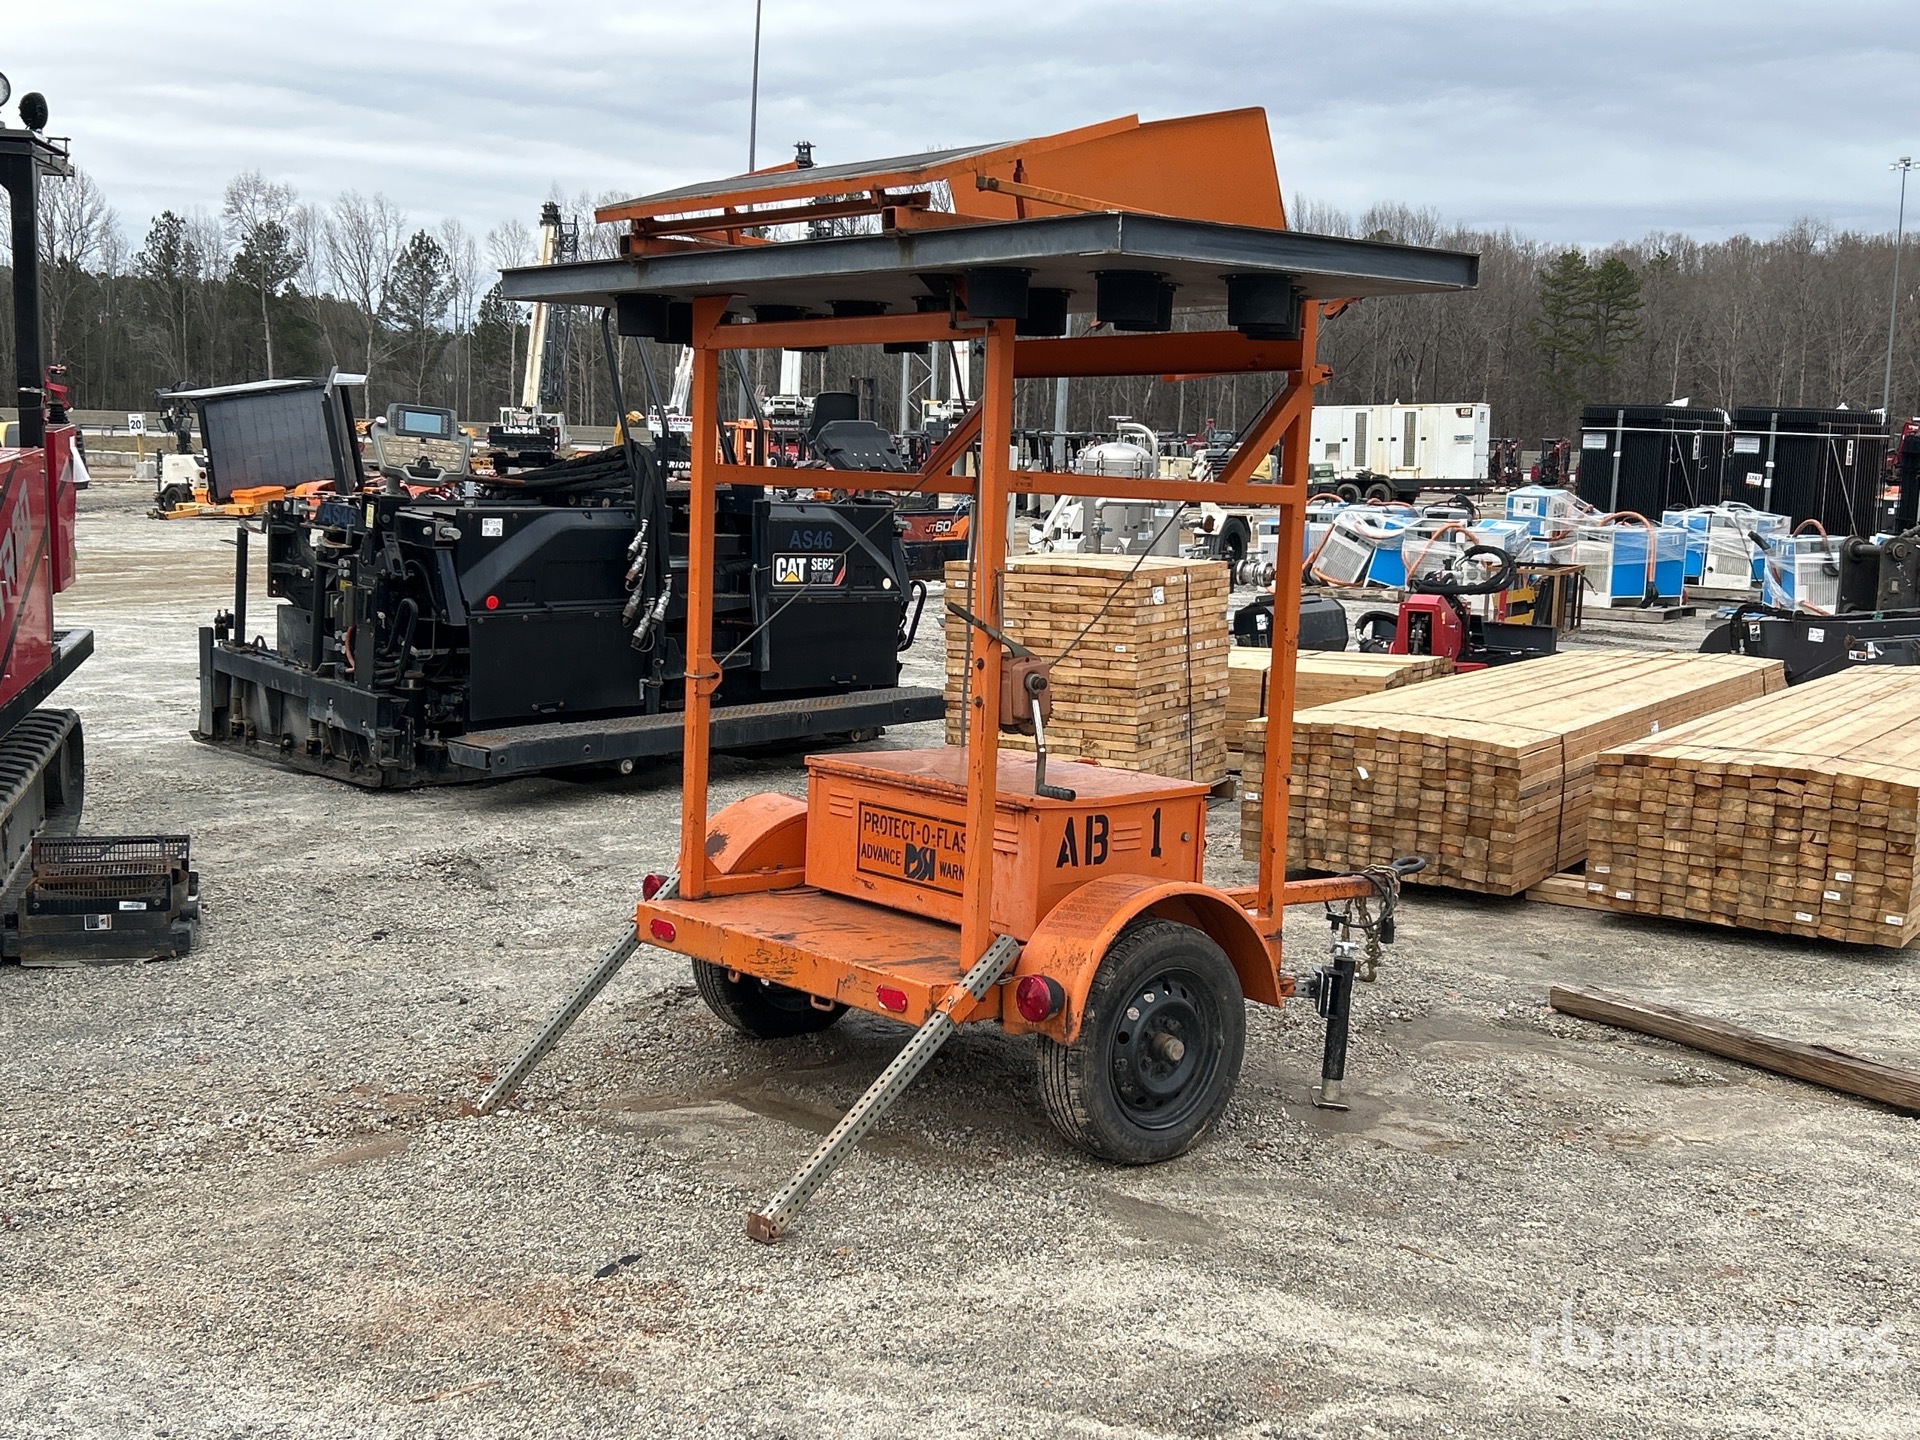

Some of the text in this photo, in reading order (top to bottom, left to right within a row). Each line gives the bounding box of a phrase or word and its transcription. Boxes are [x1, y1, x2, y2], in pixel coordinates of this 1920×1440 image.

[130, 419, 141, 429] 20
[503, 426, 540, 434] Link-Belt
[926, 520, 952, 534] JT60
[788, 529, 833, 550] AS46
[775, 557, 806, 582] CAT
[864, 811, 966, 854] PROTECT-O-FLAS
[1055, 807, 1162, 868] AB 1
[861, 843, 902, 867] ADVANCE
[939, 860, 965, 882] WARN
